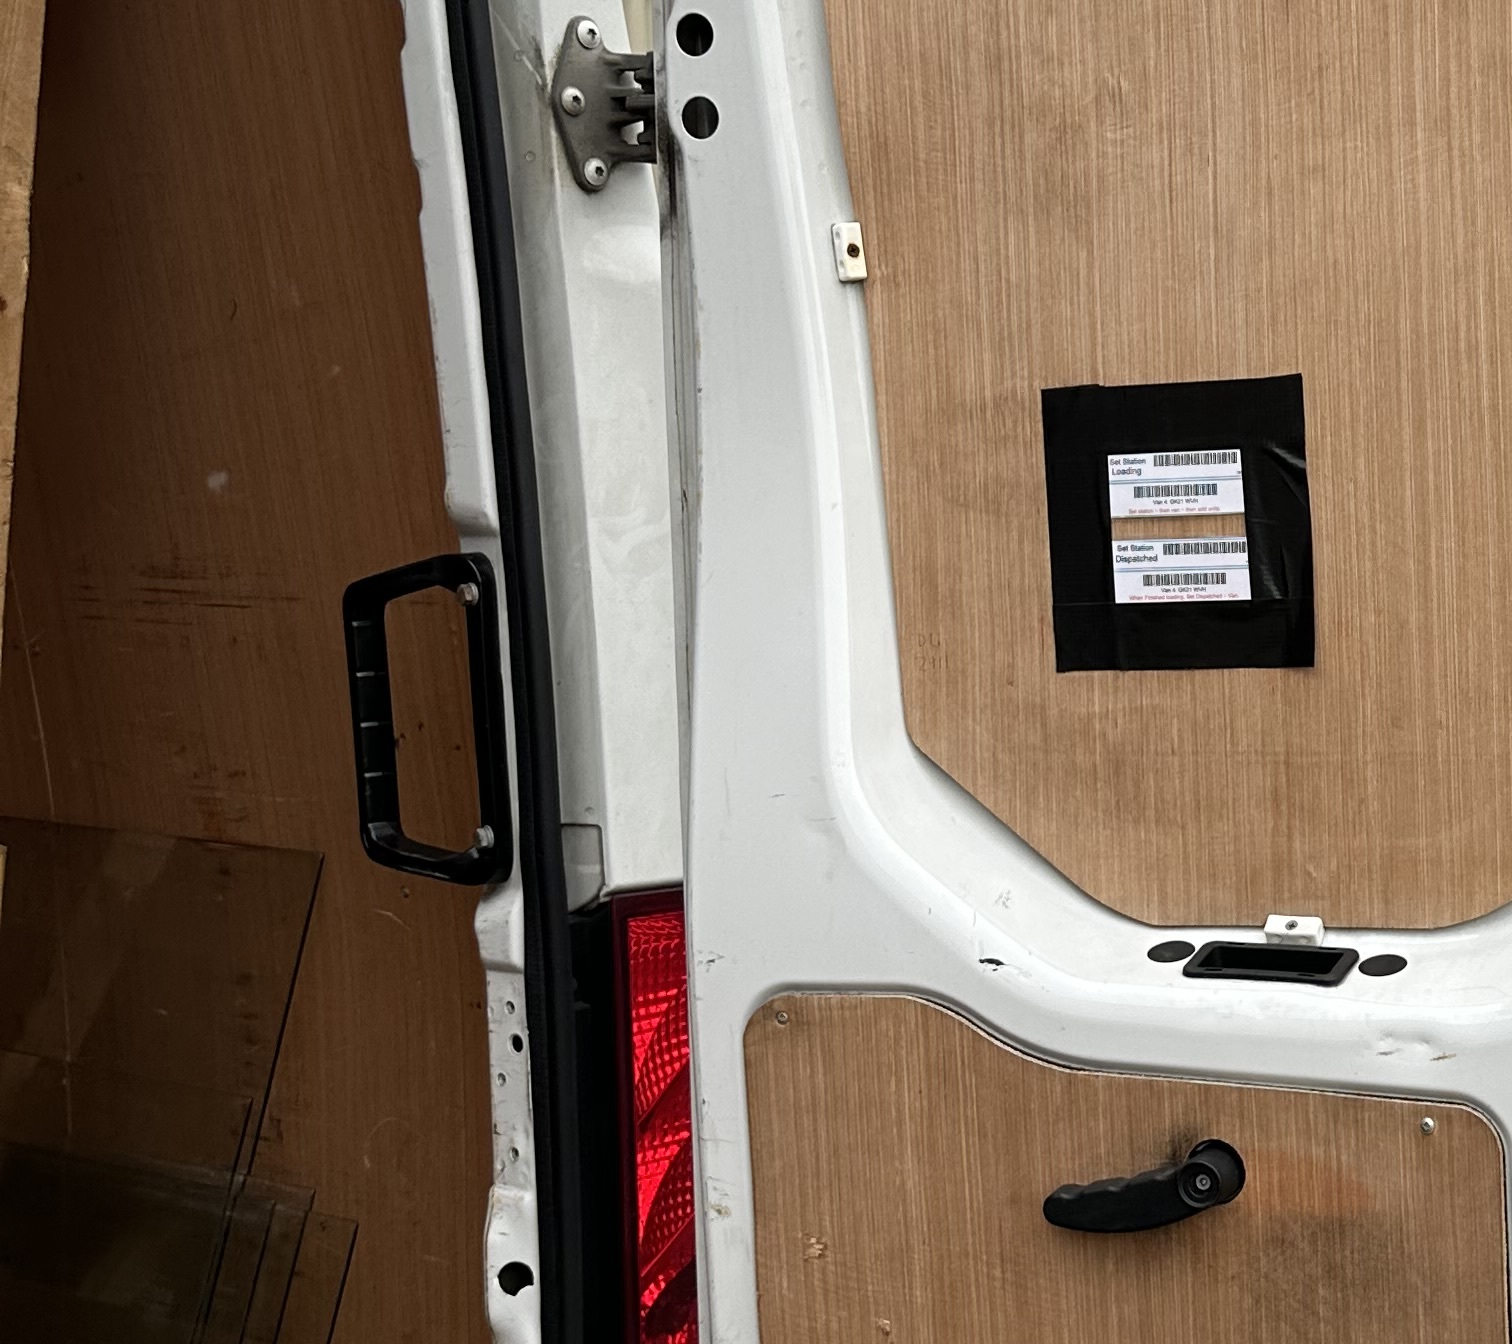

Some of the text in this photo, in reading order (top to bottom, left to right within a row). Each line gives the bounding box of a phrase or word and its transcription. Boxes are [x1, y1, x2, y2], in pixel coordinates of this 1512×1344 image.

[1123, 457, 1146, 465] Station
[1112, 467, 1142, 476] Loading
[1116, 554, 1158, 563] Dispatched
